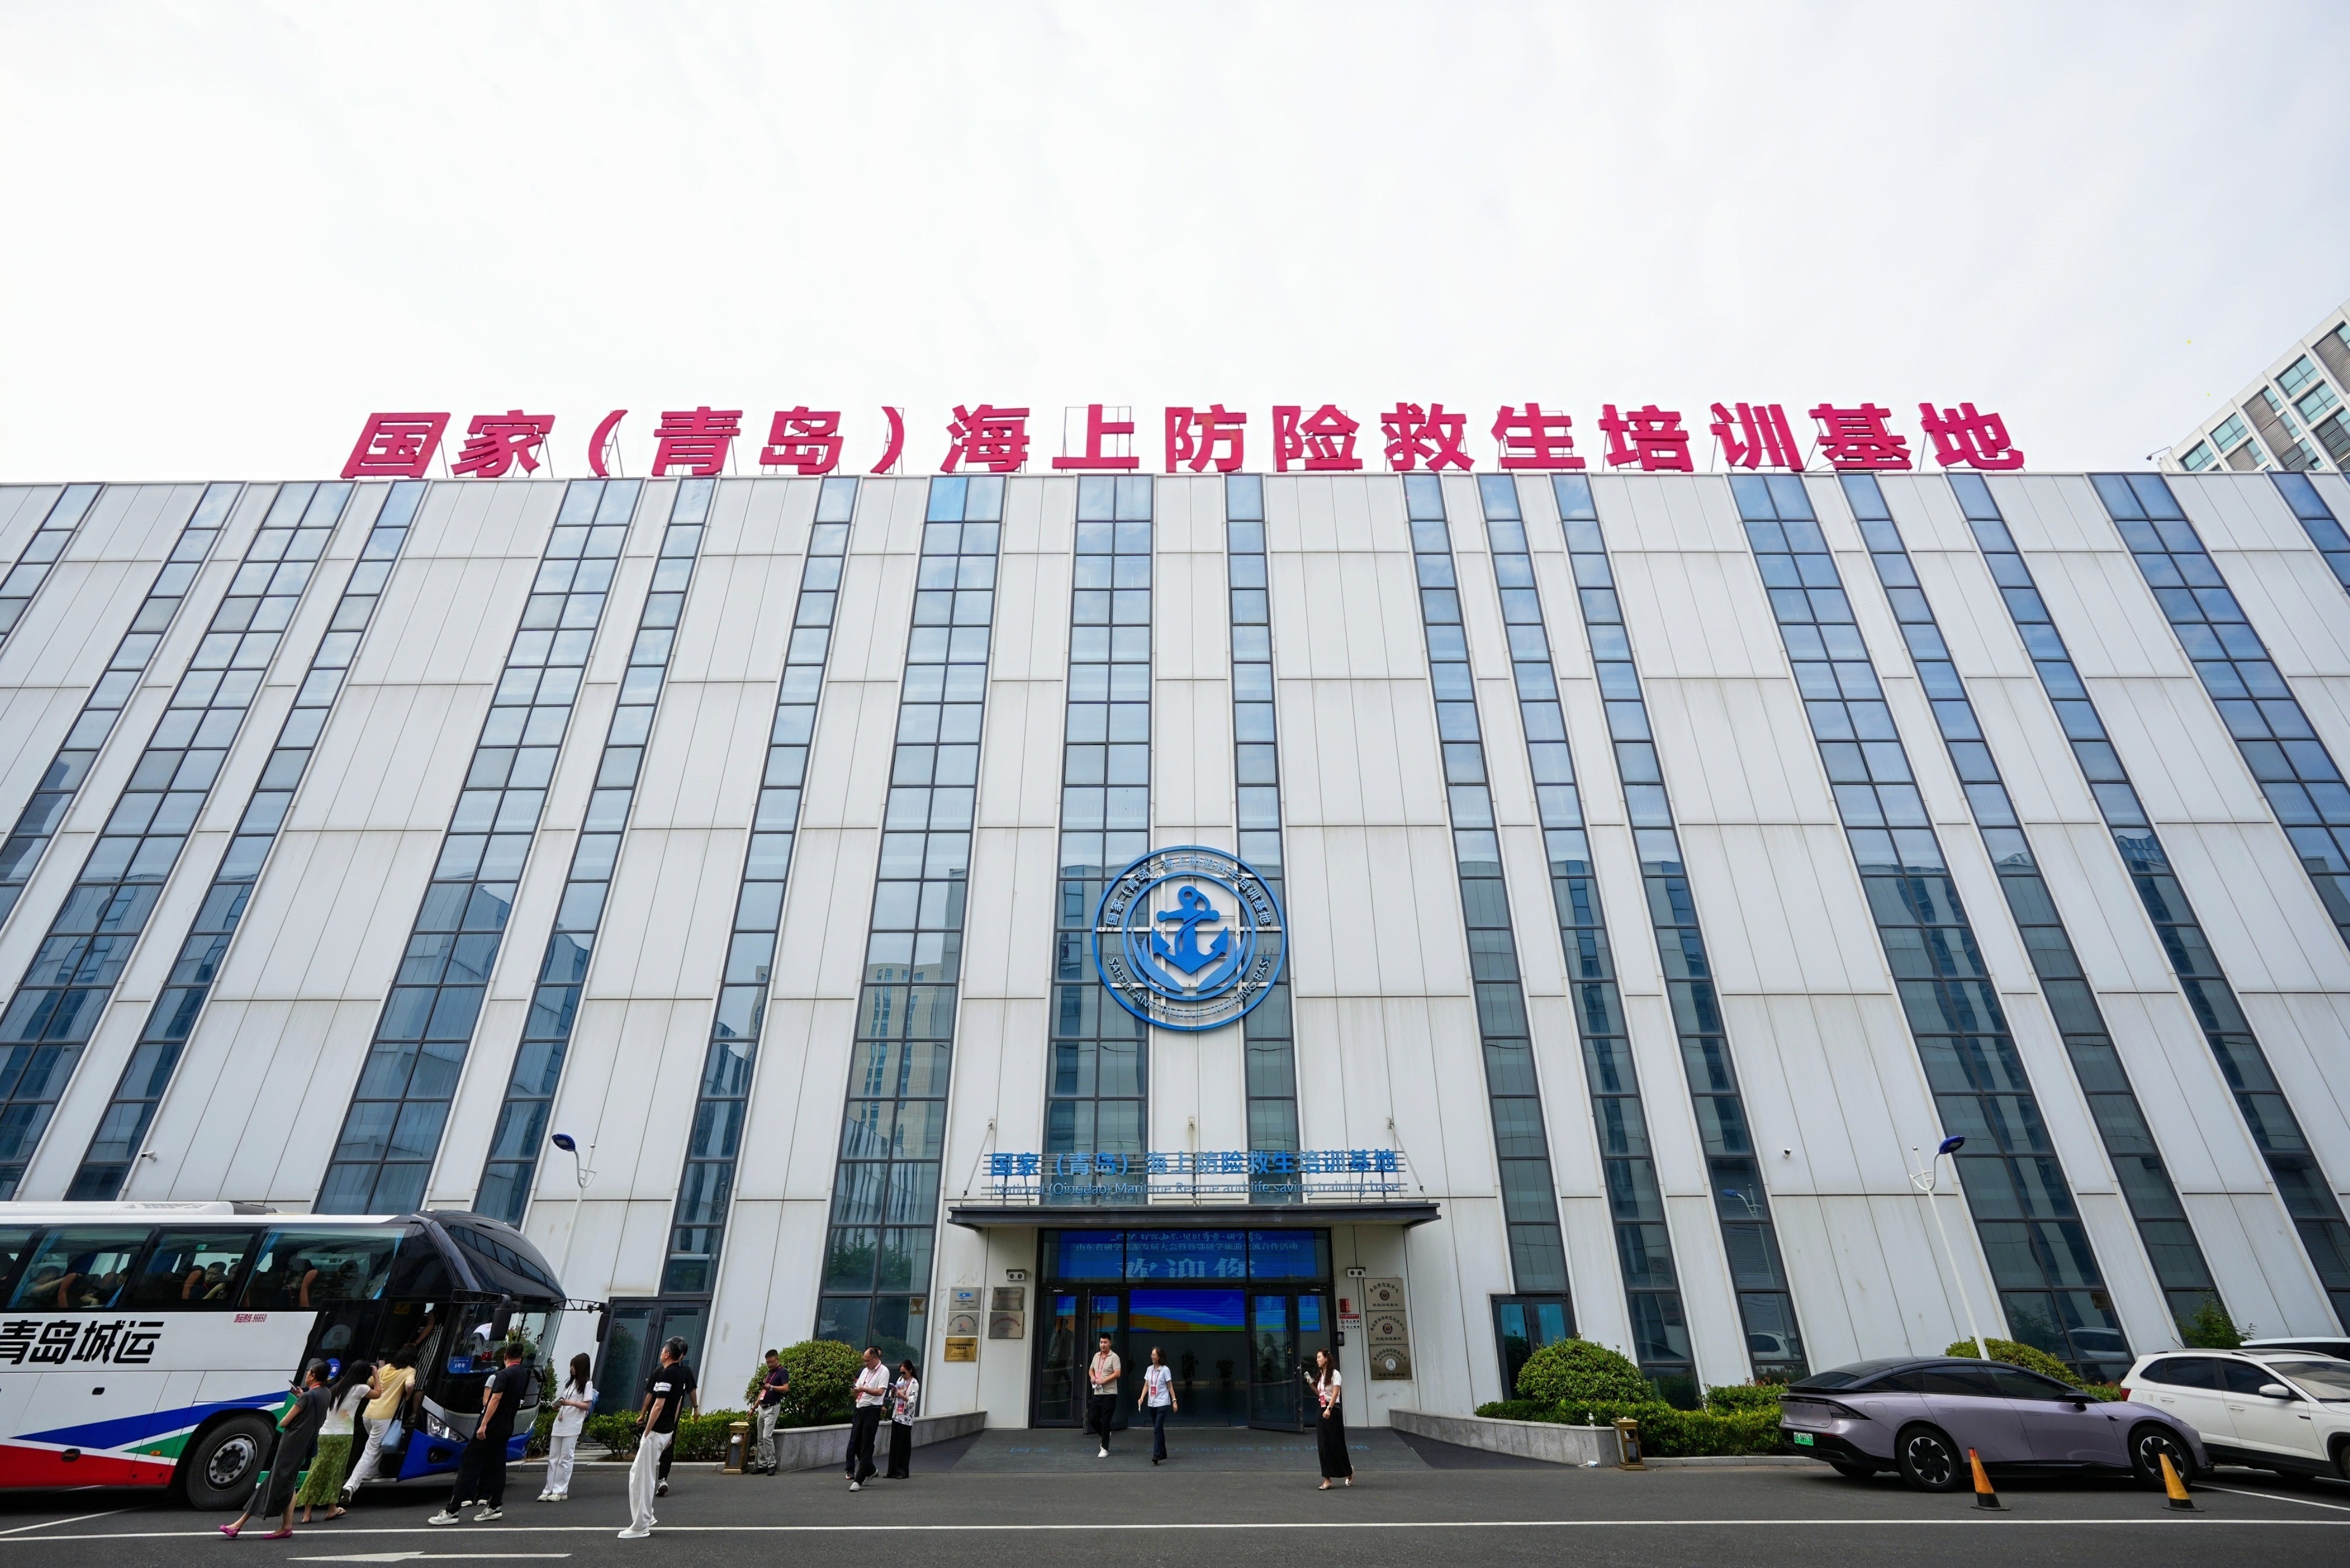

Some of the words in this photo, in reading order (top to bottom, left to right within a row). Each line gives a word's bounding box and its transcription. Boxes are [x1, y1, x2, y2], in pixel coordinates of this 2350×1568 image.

[342, 402, 2027, 479] 国家（青岛）海上防险救生培训基地
[1106, 856, 1272, 926] 国家（青岛）海上防险救生培训基地
[1108, 957, 1135, 993] SAFETY
[1133, 992, 1158, 1010] AND
[1161, 1006, 1204, 1019] RESCUE
[1210, 980, 1257, 1015] TRAINING
[991, 1149, 1398, 1176] 国家（青岛）海上防险救生培训基地
[994, 1183, 1045, 1195] National
[1049, 1182, 1110, 1198] (Qingdao)
[1115, 1182, 1171, 1195] Maritime
[1176, 1182, 1219, 1194] Rescue
[1223, 1181, 1246, 1193] and
[1251, 1180, 1269, 1193] life
[1274, 1181, 1314, 1196] saving
[1318, 1180, 1366, 1195] training
[1369, 1180, 1399, 1192] base
[0, 1320, 165, 1365] 青岛城运
